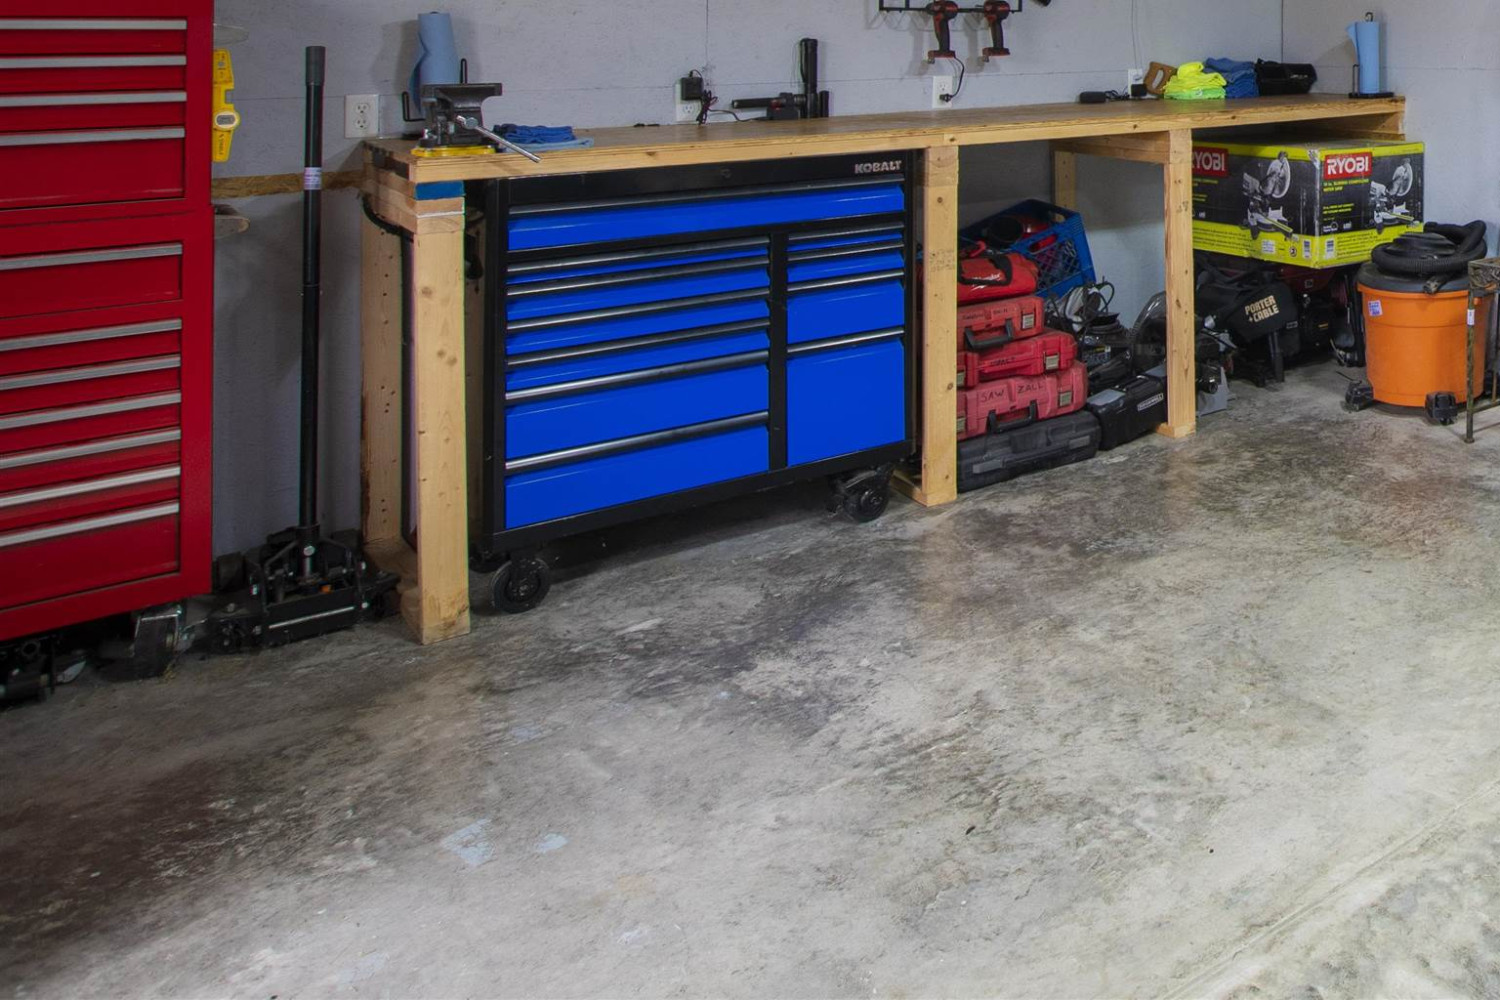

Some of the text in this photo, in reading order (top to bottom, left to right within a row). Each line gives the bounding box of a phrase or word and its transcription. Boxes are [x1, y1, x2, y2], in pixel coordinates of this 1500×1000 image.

[854, 160, 902, 174] KOBALT
[1326, 156, 1370, 175] RYOBI
[1245, 295, 1276, 315] PORTER
[981, 379, 1045, 402] SAW ZALL
